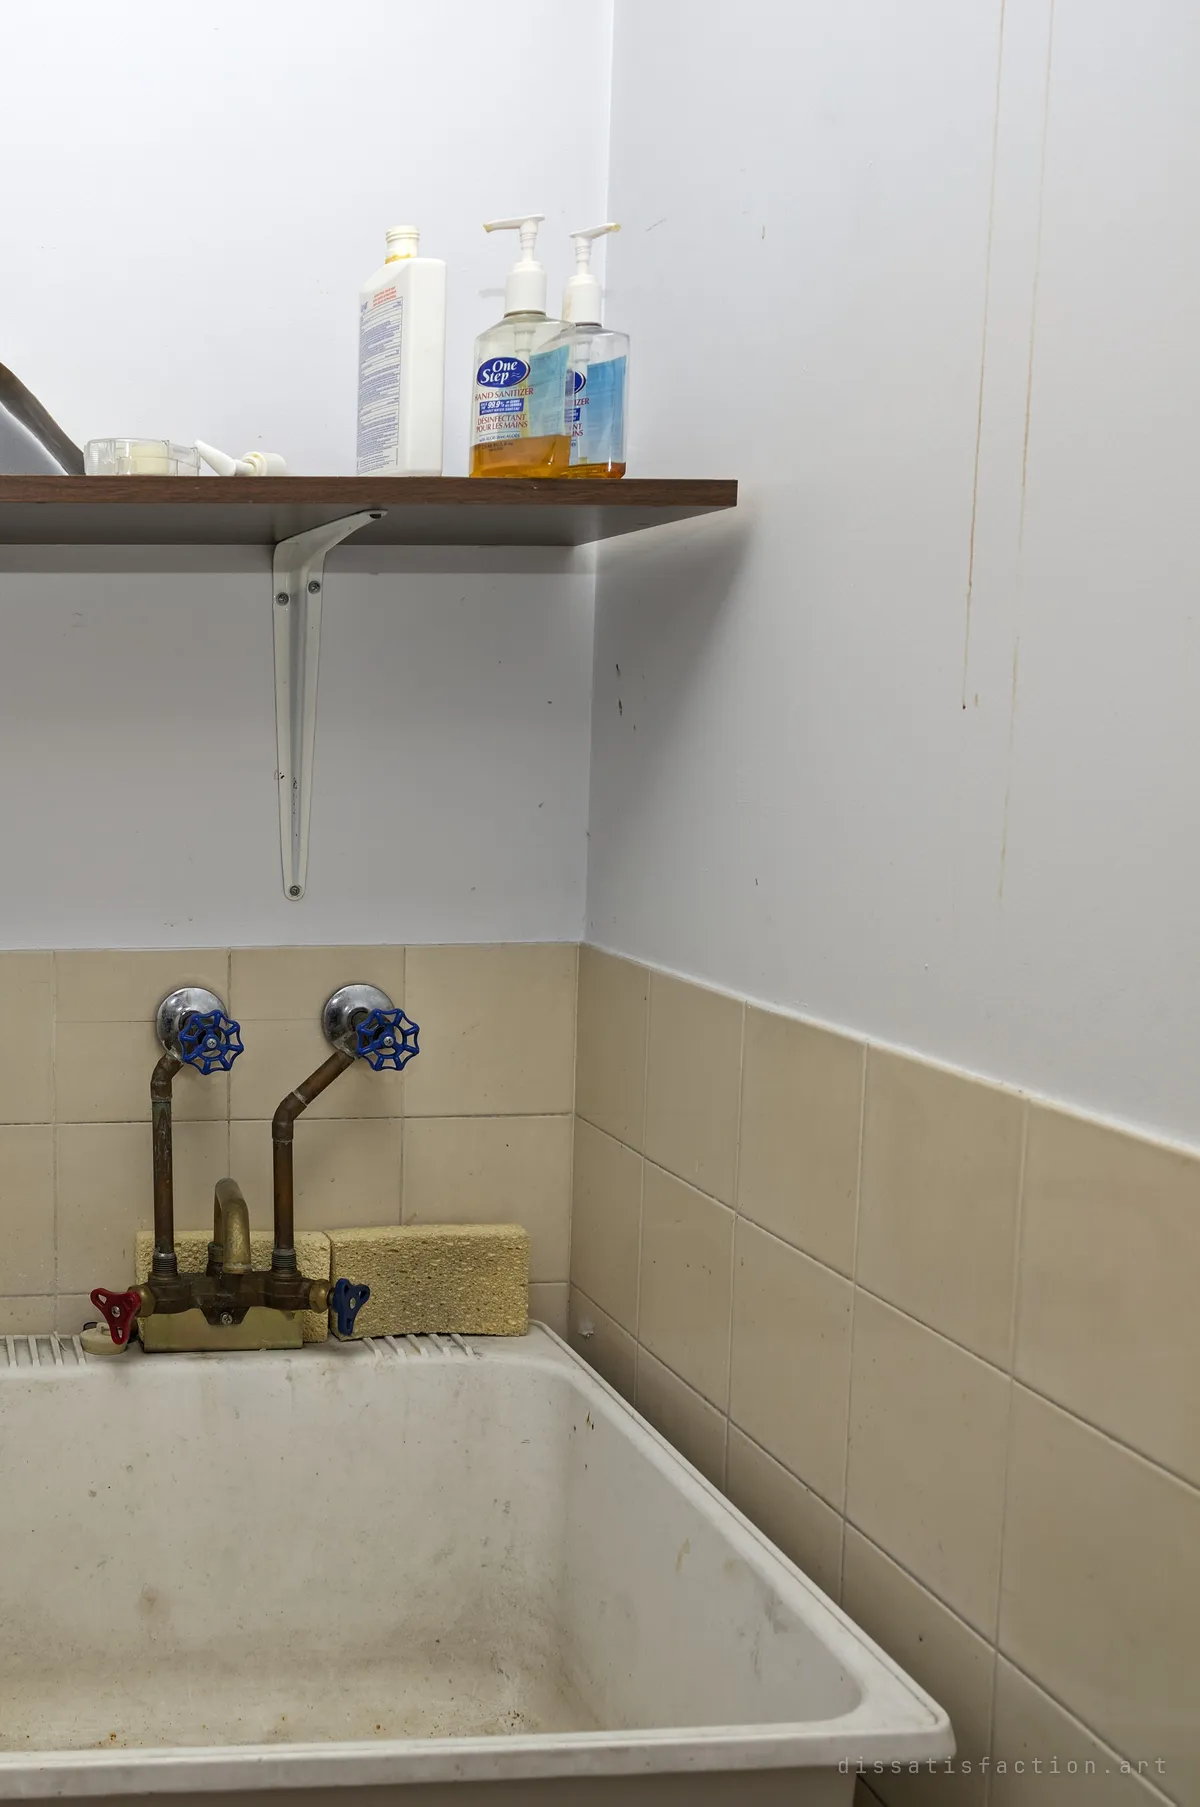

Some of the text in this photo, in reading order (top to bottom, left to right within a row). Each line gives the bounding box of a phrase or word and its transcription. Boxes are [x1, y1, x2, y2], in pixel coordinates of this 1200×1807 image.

[492, 360, 518, 373] One
[480, 368, 509, 385] Step
[495, 387, 534, 398] SANITIZER
[477, 413, 526, 426] DÉSINFECTANT
[476, 421, 528, 433] POUR LES MAINS
